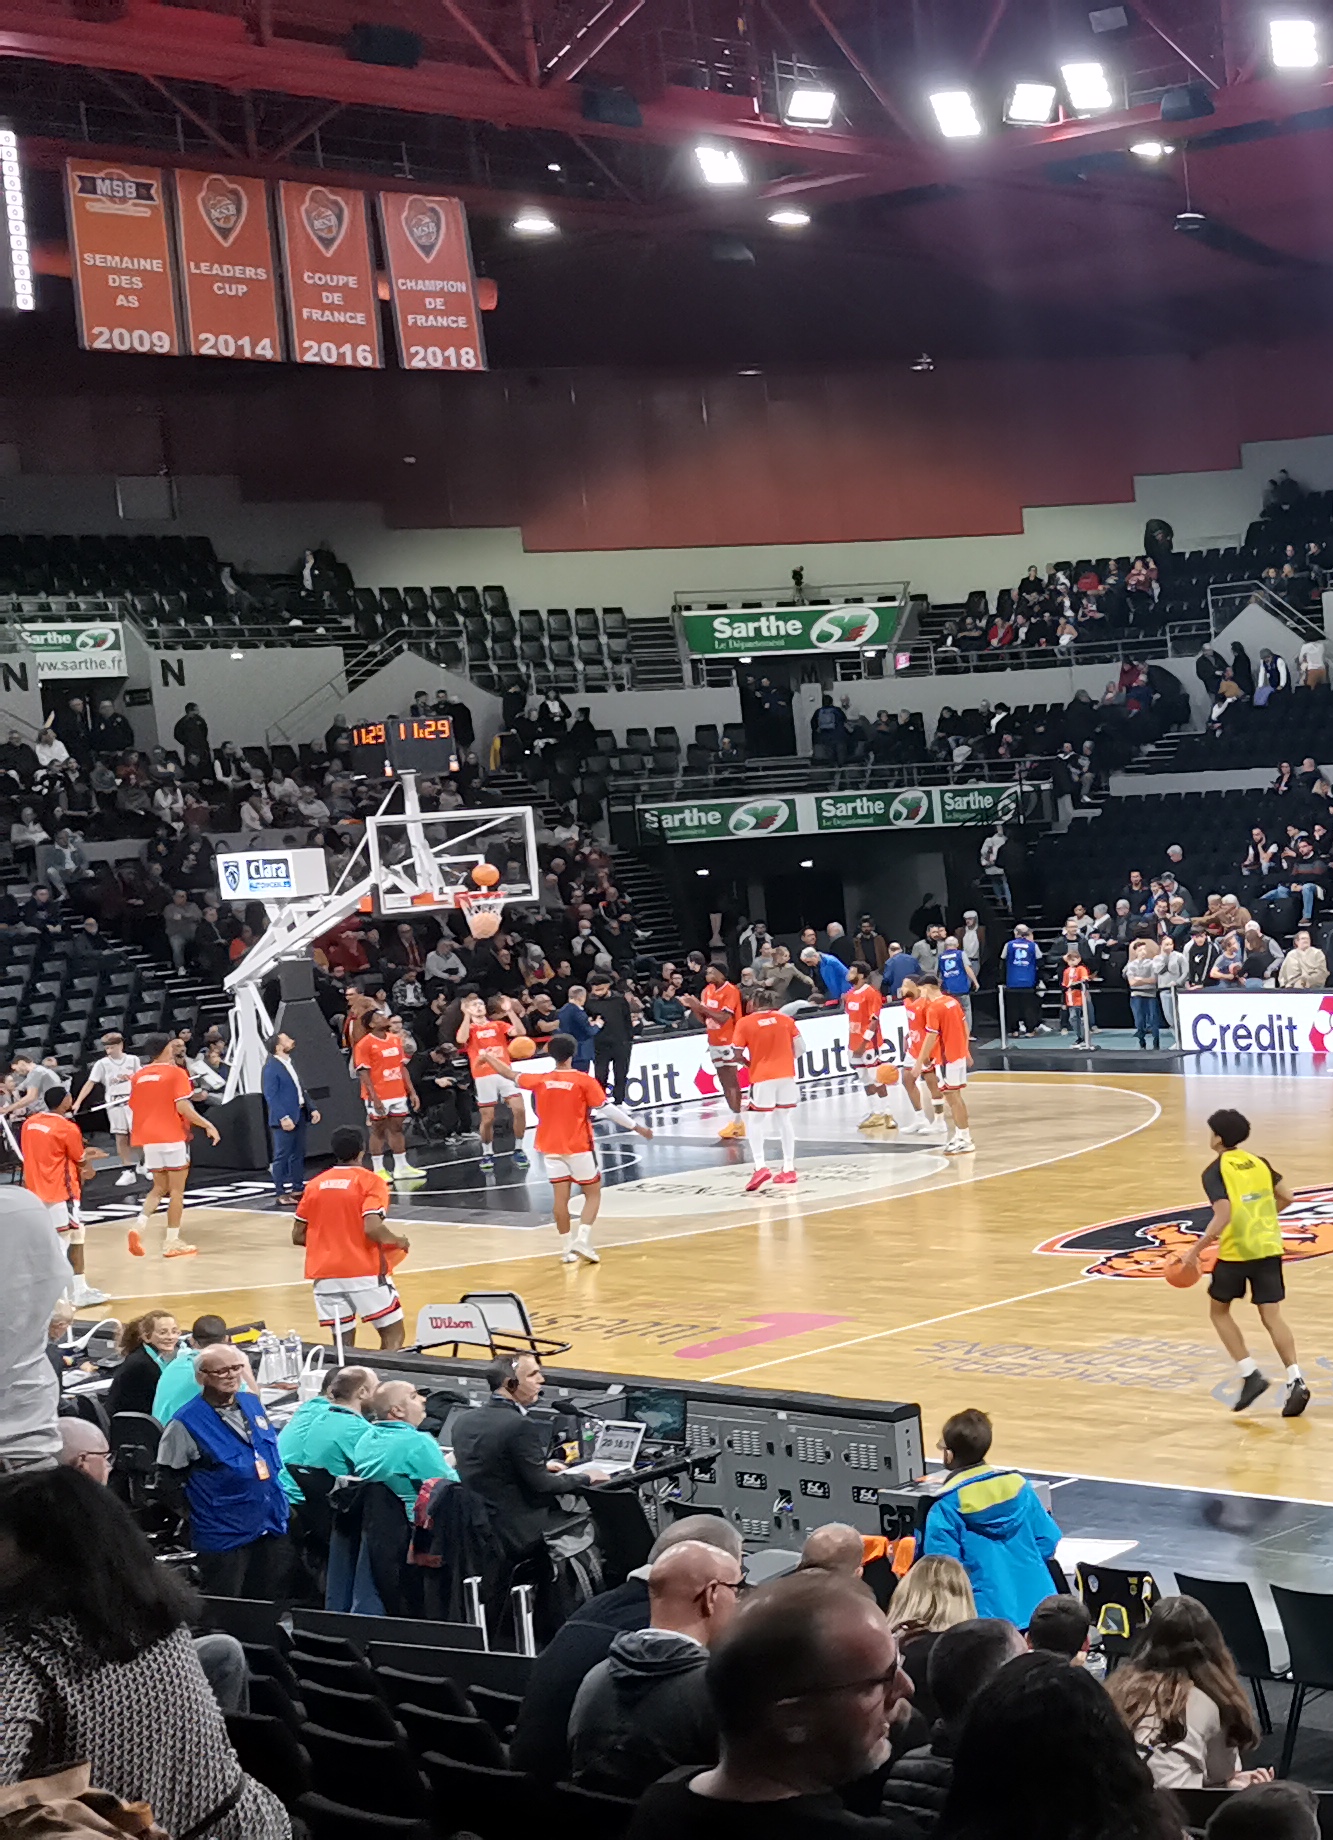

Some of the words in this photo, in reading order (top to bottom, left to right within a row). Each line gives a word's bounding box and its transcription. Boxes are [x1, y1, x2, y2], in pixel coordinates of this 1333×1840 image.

[95, 179, 137, 198] MSB
[83, 253, 164, 273] SEMAINE
[189, 261, 268, 280] LEADERS
[107, 275, 143, 289] DES
[213, 282, 248, 297] CUP
[303, 271, 358, 289] COUPE
[397, 278, 467, 293] CHAMPION
[116, 294, 140, 308] AS
[321, 291, 344, 305] DE
[425, 297, 446, 310] DE
[302, 308, 367, 326] FRANCE
[407, 314, 468, 329] FRANCE
[91, 326, 171, 354] 2009
[198, 333, 275, 360] 2014
[302, 340, 373, 367] 2016
[409, 345, 477, 369] 2018
[713, 614, 803, 640] Sarthe
[21, 631, 72, 645] Sarthe
[714, 640, 727, 650] Le
[2, 661, 29, 692] N
[160, 657, 186, 687] N
[352, 723, 386, 747] 11:29
[398, 719, 451, 741] 11:29
[821, 796, 886, 819] Sarthe
[943, 791, 995, 811] Sarthe
[644, 808, 722, 829] Sarthe
[249, 859, 287, 879] Clara
[1191, 1012, 1299, 1052] Crédit
[428, 1315, 476, 1331] Wilson
